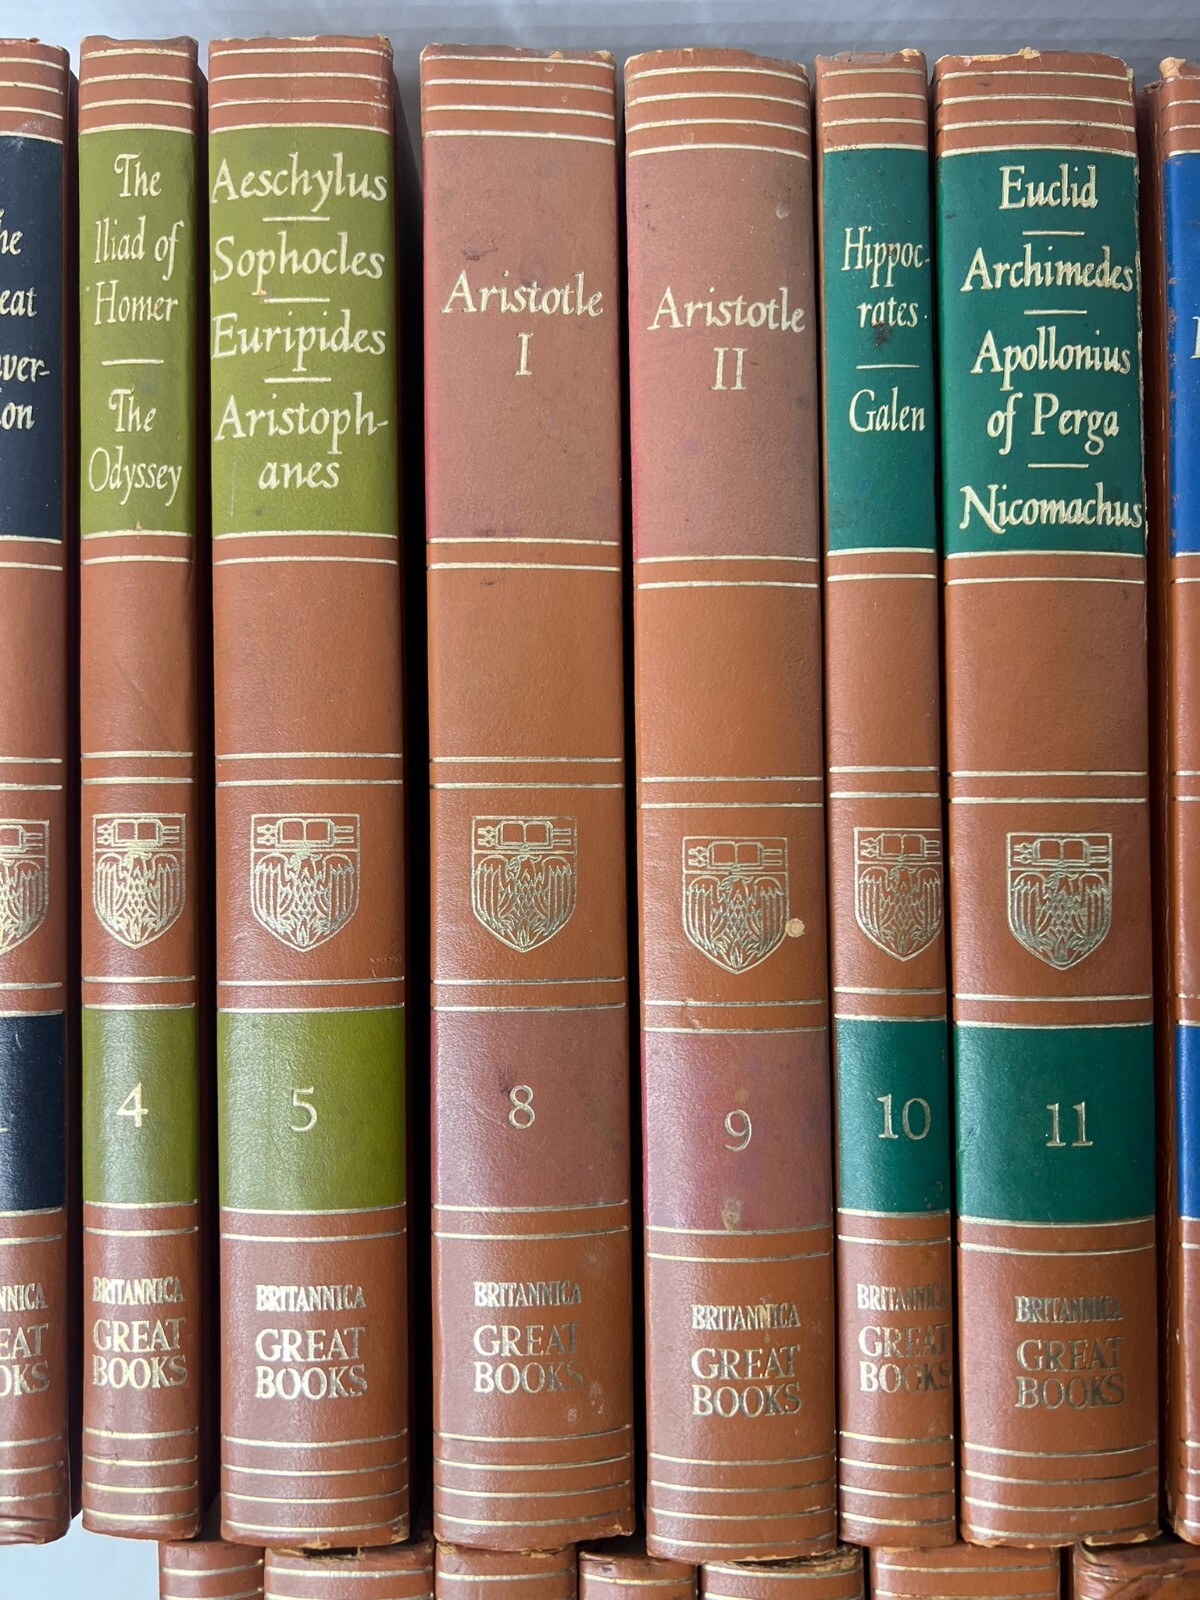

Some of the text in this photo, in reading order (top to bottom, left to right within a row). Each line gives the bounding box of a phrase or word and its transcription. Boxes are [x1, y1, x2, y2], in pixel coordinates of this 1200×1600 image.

[113, 152, 162, 197] The
[211, 152, 388, 212] Aeschylus
[998, 164, 1099, 210] Euclid
[0, 207, 23, 255] he
[94, 216, 185, 281] Iliad of
[212, 231, 386, 296] Sophocles
[840, 226, 930, 289] Hippoc-
[960, 243, 1134, 293] Archimedes
[0, 287, 37, 317] eat
[94, 279, 179, 326] Homer
[440, 270, 604, 317] Aristotle
[646, 286, 806, 334] Aristotle
[856, 296, 919, 329] rates
[211, 309, 387, 372] Euripides
[514, 332, 534, 376] I
[970, 325, 1132, 391] Apollonius
[0, 353, 50, 383] ver-
[710, 347, 748, 391] II
[108, 387, 156, 433] The
[214, 392, 390, 455] Aristoph-
[848, 387, 926, 434] Galen
[986, 391, 1120, 456] of Perga
[88, 446, 182, 507] Odyssey
[258, 461, 340, 490] anes
[959, 482, 1143, 535] Nicomachus
[115, 1082, 149, 1128] 4
[289, 1086, 318, 1132] 5
[508, 1085, 536, 1130] 8
[876, 1094, 932, 1140] 10
[1044, 1101, 1094, 1146] 11
[723, 1109, 753, 1152] 9
[92, 1276, 185, 1304] BRITANNICA
[255, 1284, 366, 1312] BRITANNICA
[473, 1281, 583, 1309] BRITANNICA
[1014, 1295, 1124, 1323] BRITANNICA
[92, 1318, 187, 1352] GREAT
[473, 1322, 583, 1357] GREAT
[690, 1304, 801, 1331] BRITANNICA
[0, 1323, 49, 1360] EAT
[254, 1326, 366, 1362] GREAT
[690, 1345, 801, 1380] GREAT
[857, 1323, 949, 1358] GREAT
[1015, 1336, 1125, 1373] GREAT
[0, 1361, 50, 1396] OKS
[92, 1355, 188, 1389] BOOKS
[254, 1364, 368, 1400] BOOKS
[473, 1361, 584, 1395] BOOKS
[858, 1360, 951, 1394] BOOKS
[1014, 1374, 1126, 1410] BOOKS
[691, 1383, 802, 1417] BOOKS
